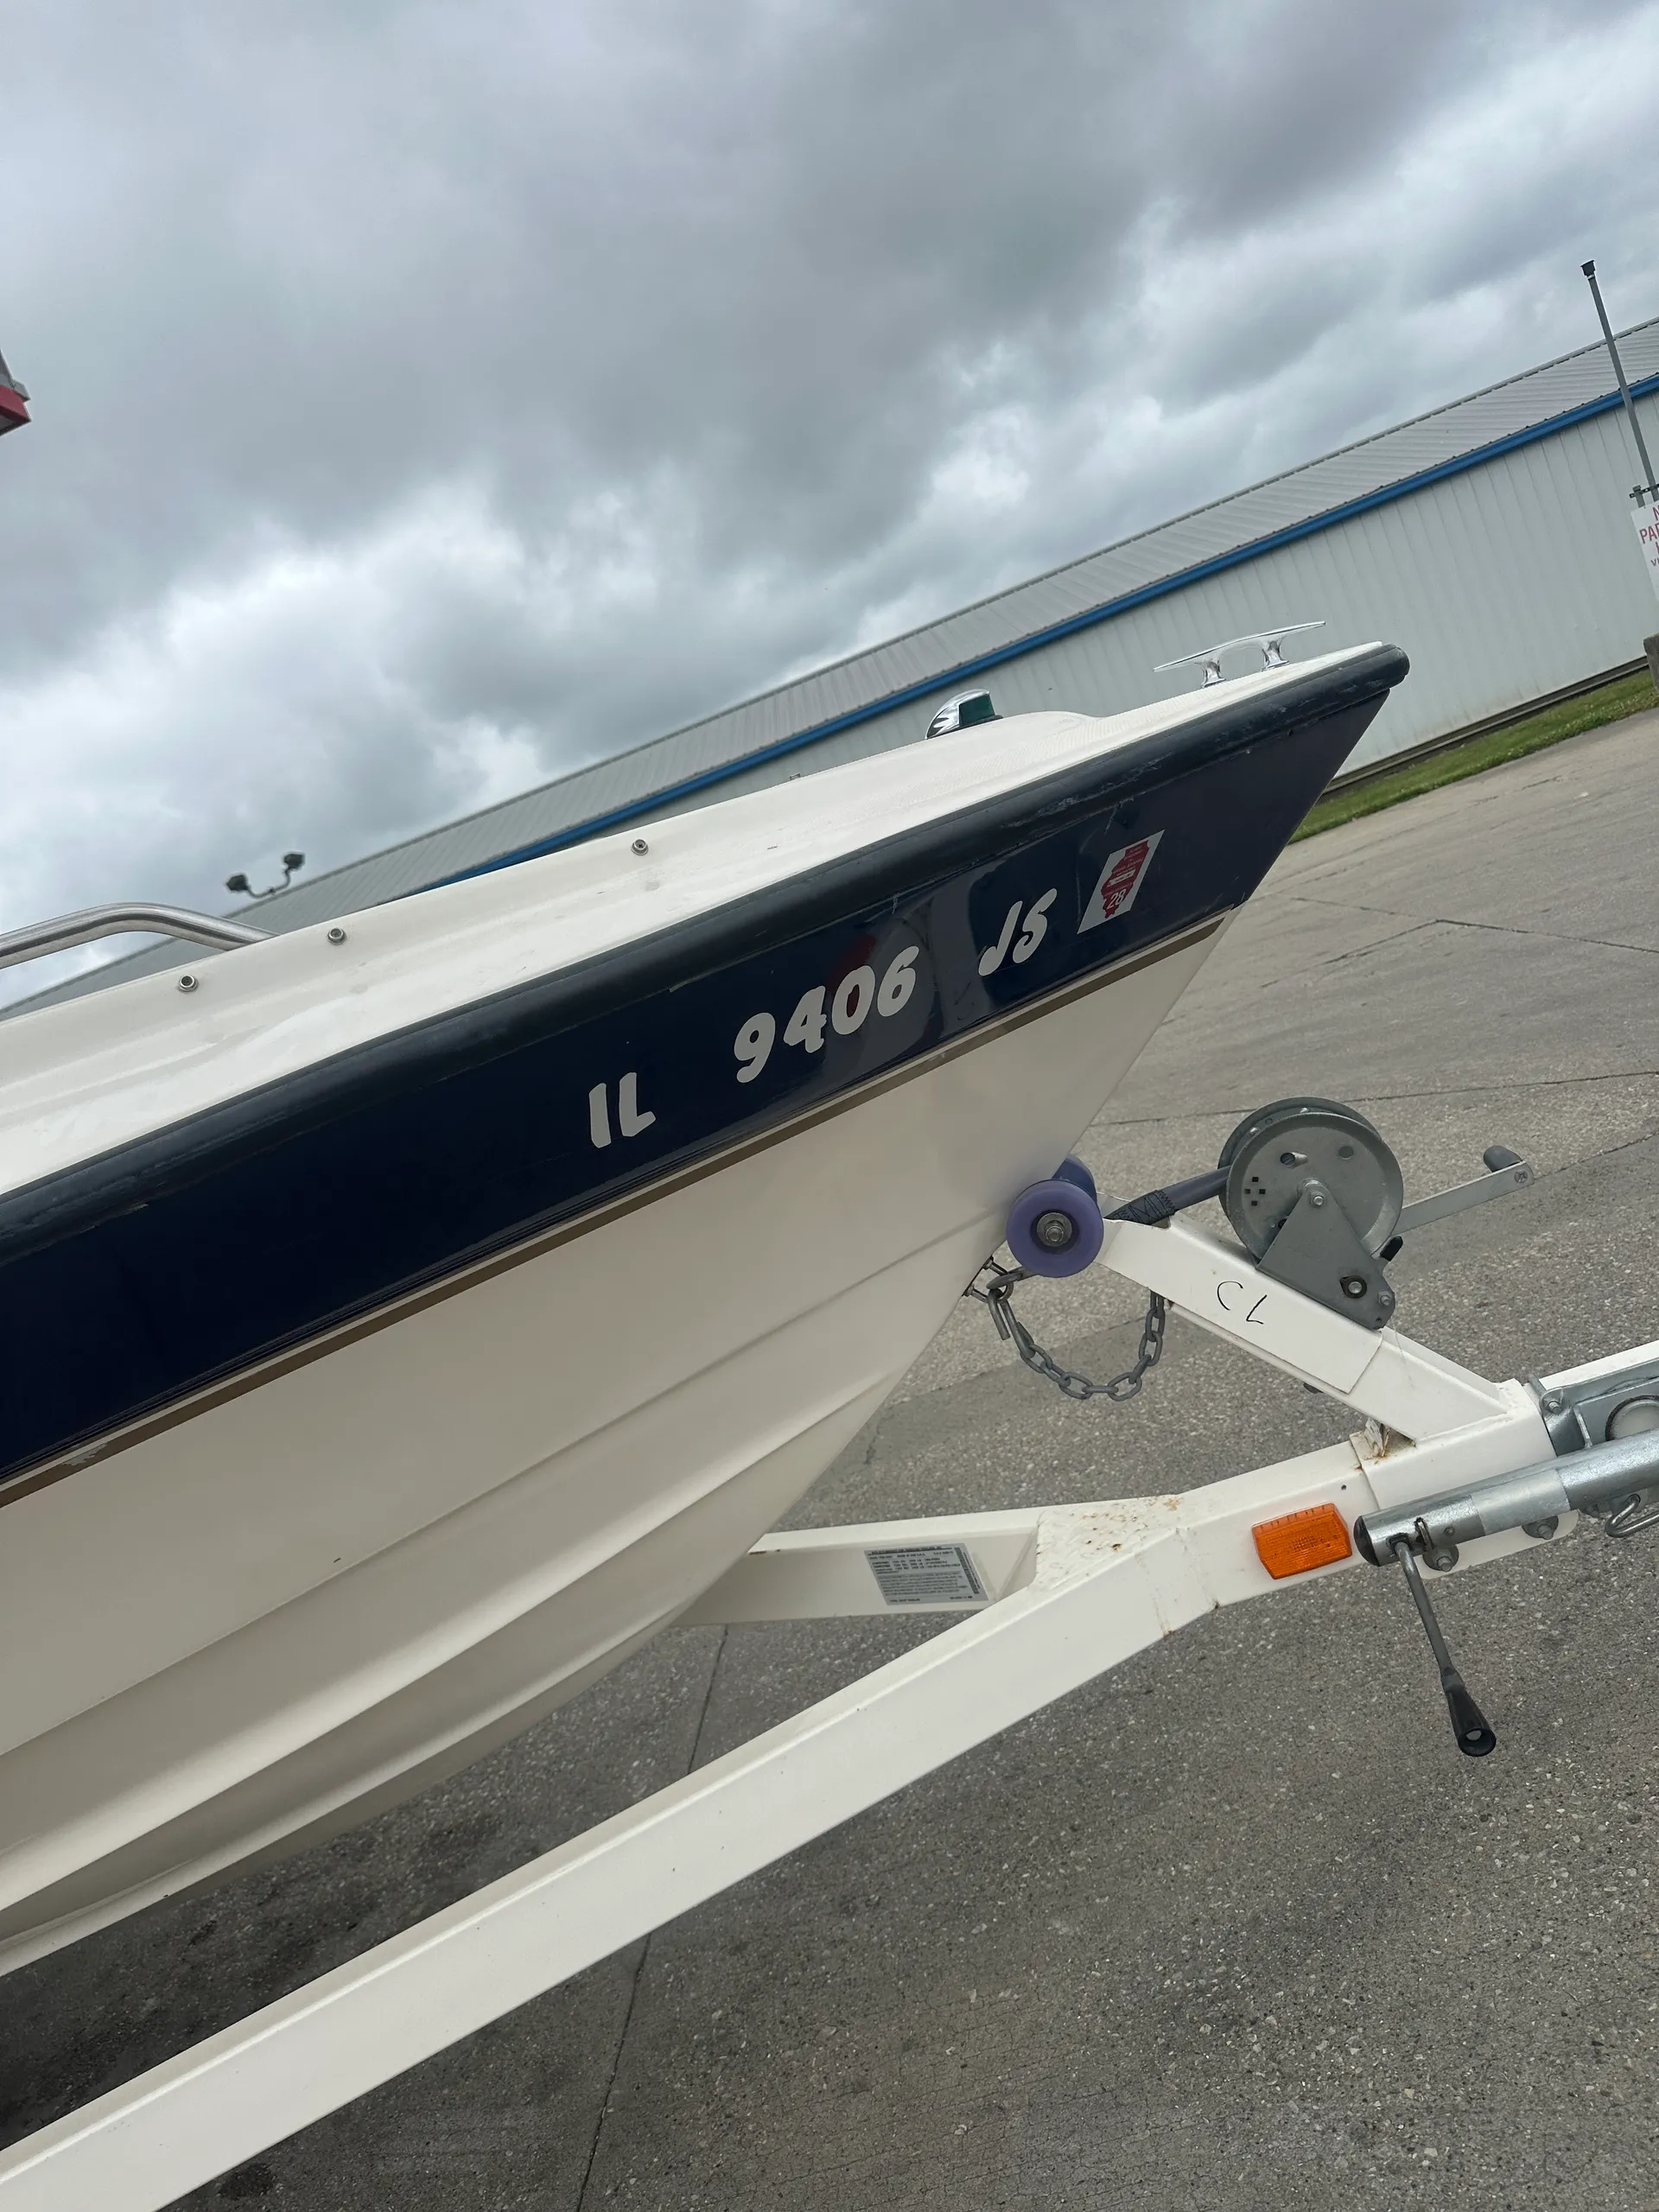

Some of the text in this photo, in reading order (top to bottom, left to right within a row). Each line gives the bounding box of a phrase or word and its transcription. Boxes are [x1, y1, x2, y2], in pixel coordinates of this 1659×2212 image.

[1106, 888, 1127, 910] 28
[589, 888, 1057, 1148] IL 9406 JS
